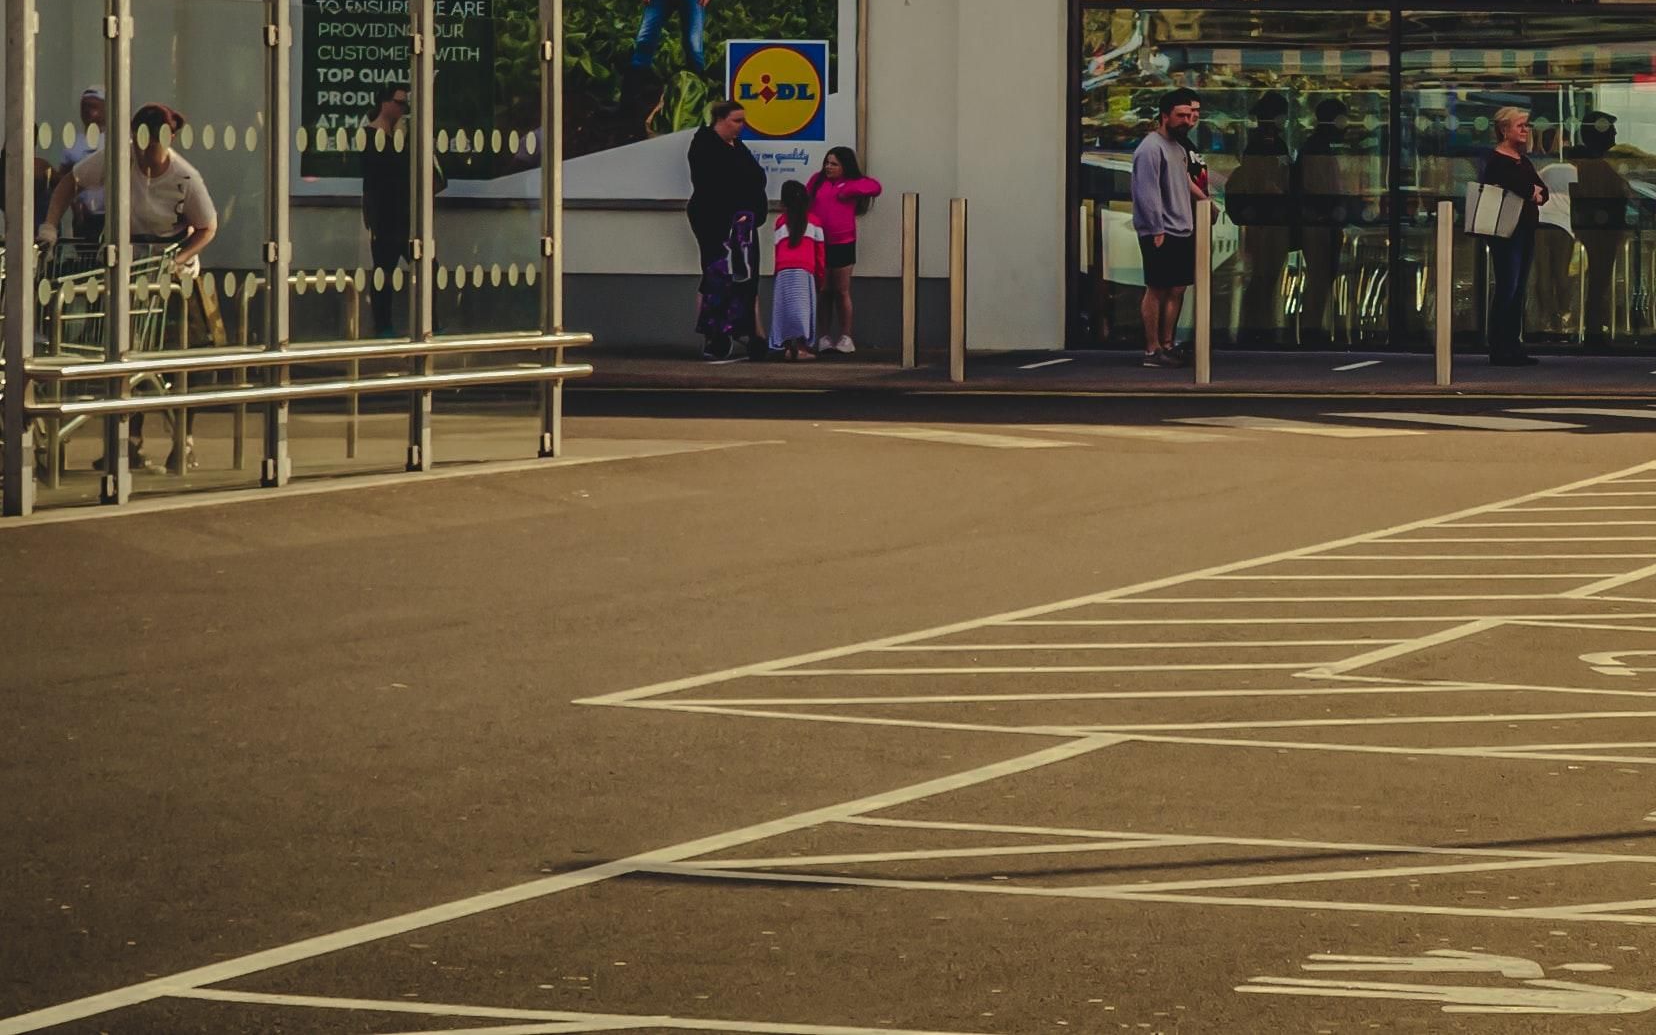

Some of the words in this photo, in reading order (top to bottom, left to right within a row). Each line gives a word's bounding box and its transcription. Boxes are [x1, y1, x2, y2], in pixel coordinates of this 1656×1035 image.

[316, 0, 340, 15] TO
[450, 1, 486, 17] ARE
[317, 45, 410, 61] CUSTOME
[435, 47, 480, 63] WITH
[316, 68, 355, 84] TOP
[316, 114, 340, 129] AT
